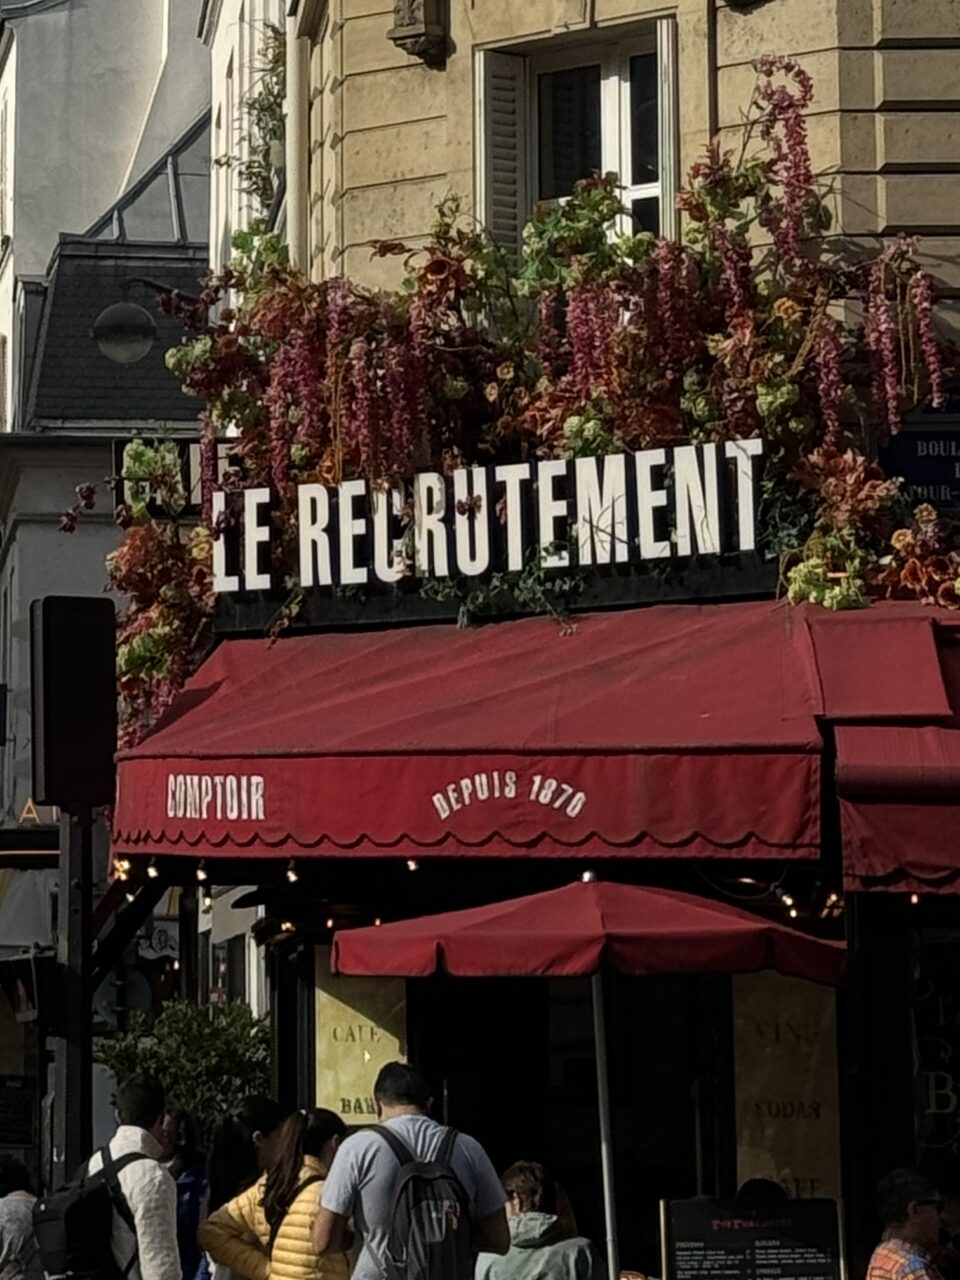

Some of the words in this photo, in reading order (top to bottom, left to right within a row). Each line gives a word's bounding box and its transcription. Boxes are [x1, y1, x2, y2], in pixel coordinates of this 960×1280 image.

[212, 487, 272, 594] LE
[297, 438, 764, 588] RECRUTEMENT
[167, 773, 265, 820] COMPTOIR
[431, 770, 518, 820] DEPUIS
[529, 774, 587, 819] 1870
